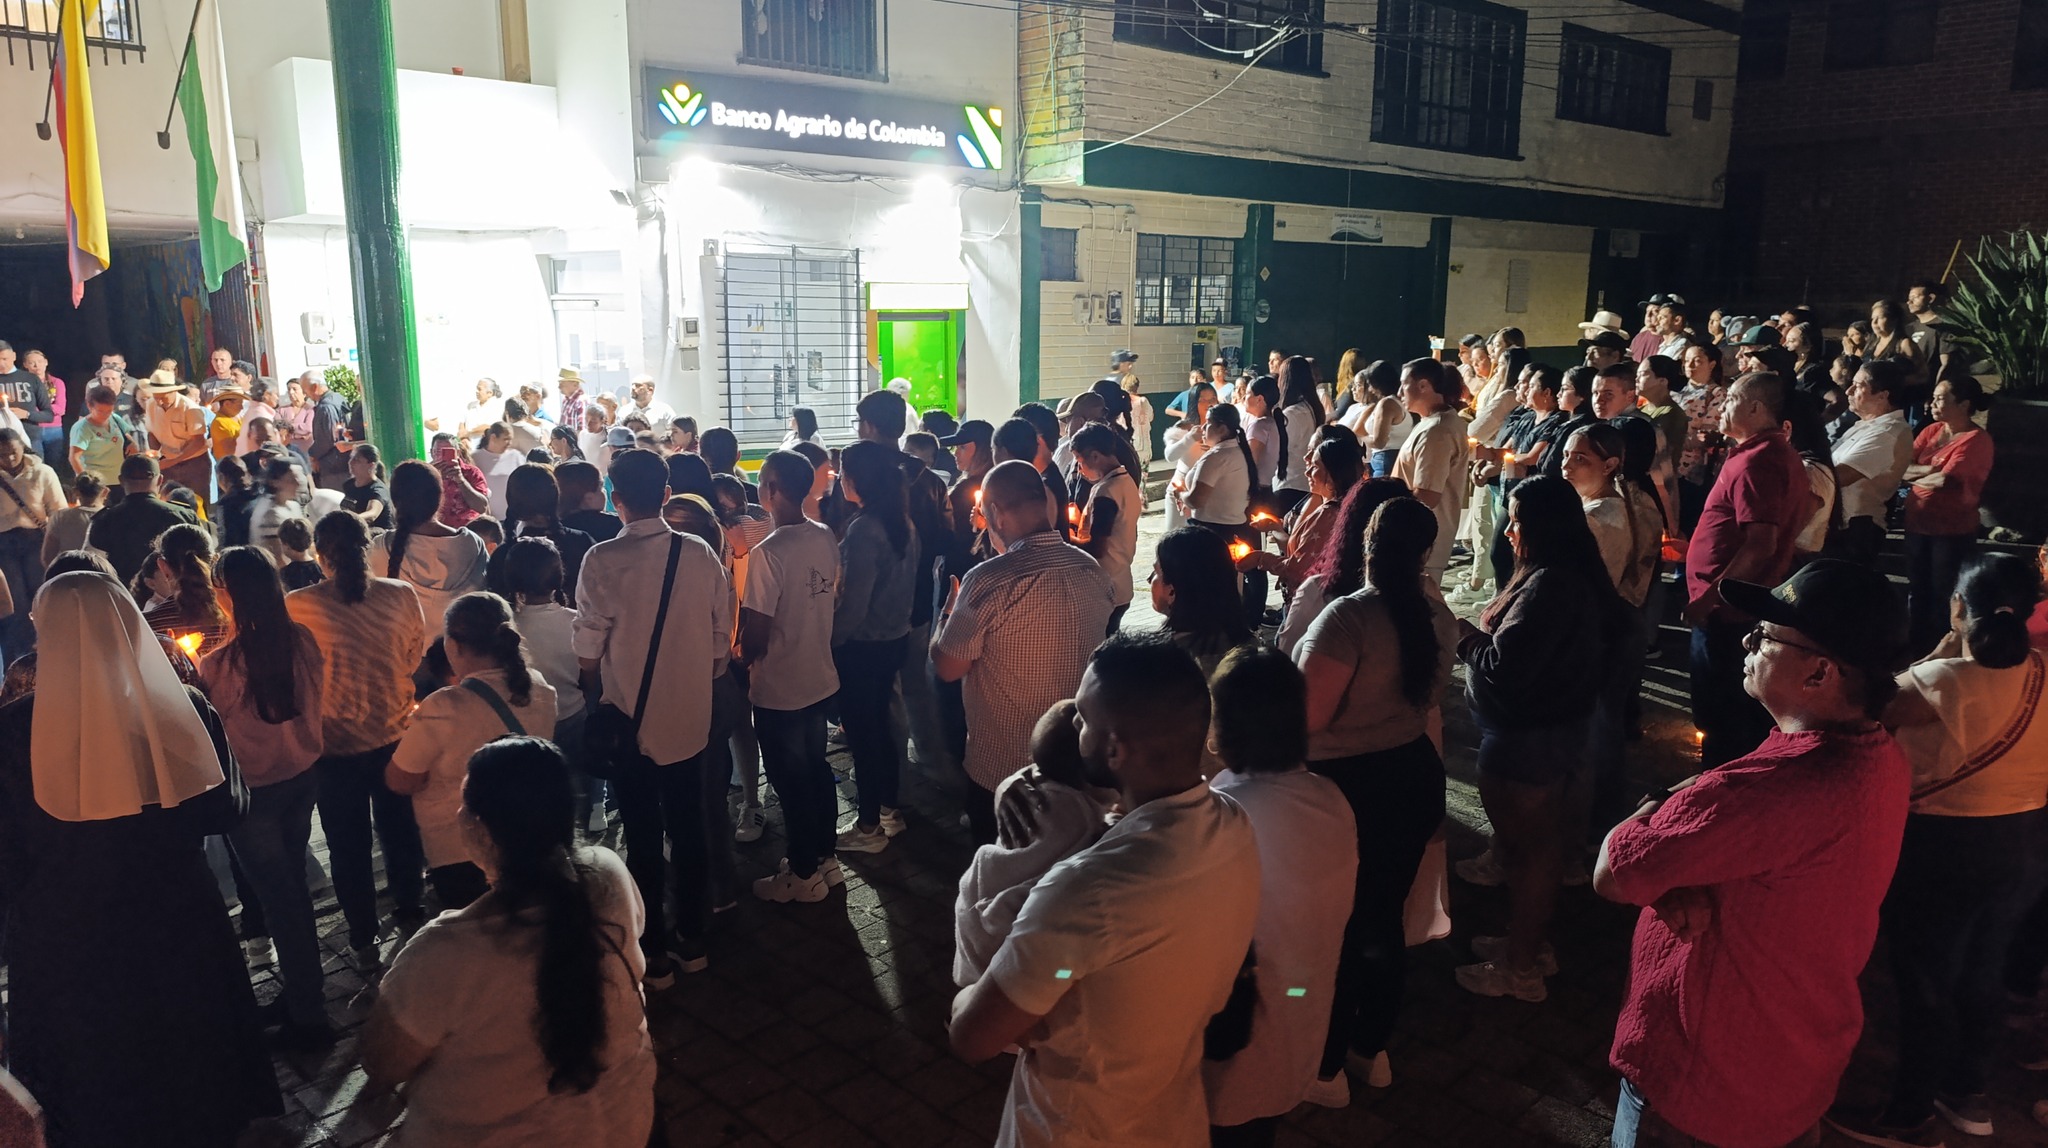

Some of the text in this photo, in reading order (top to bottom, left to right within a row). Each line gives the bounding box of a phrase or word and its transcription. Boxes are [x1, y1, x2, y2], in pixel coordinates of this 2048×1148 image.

[711, 101, 946, 148] Banco Agrario de Colombia
[1784, 584, 1797, 602] BOSS
